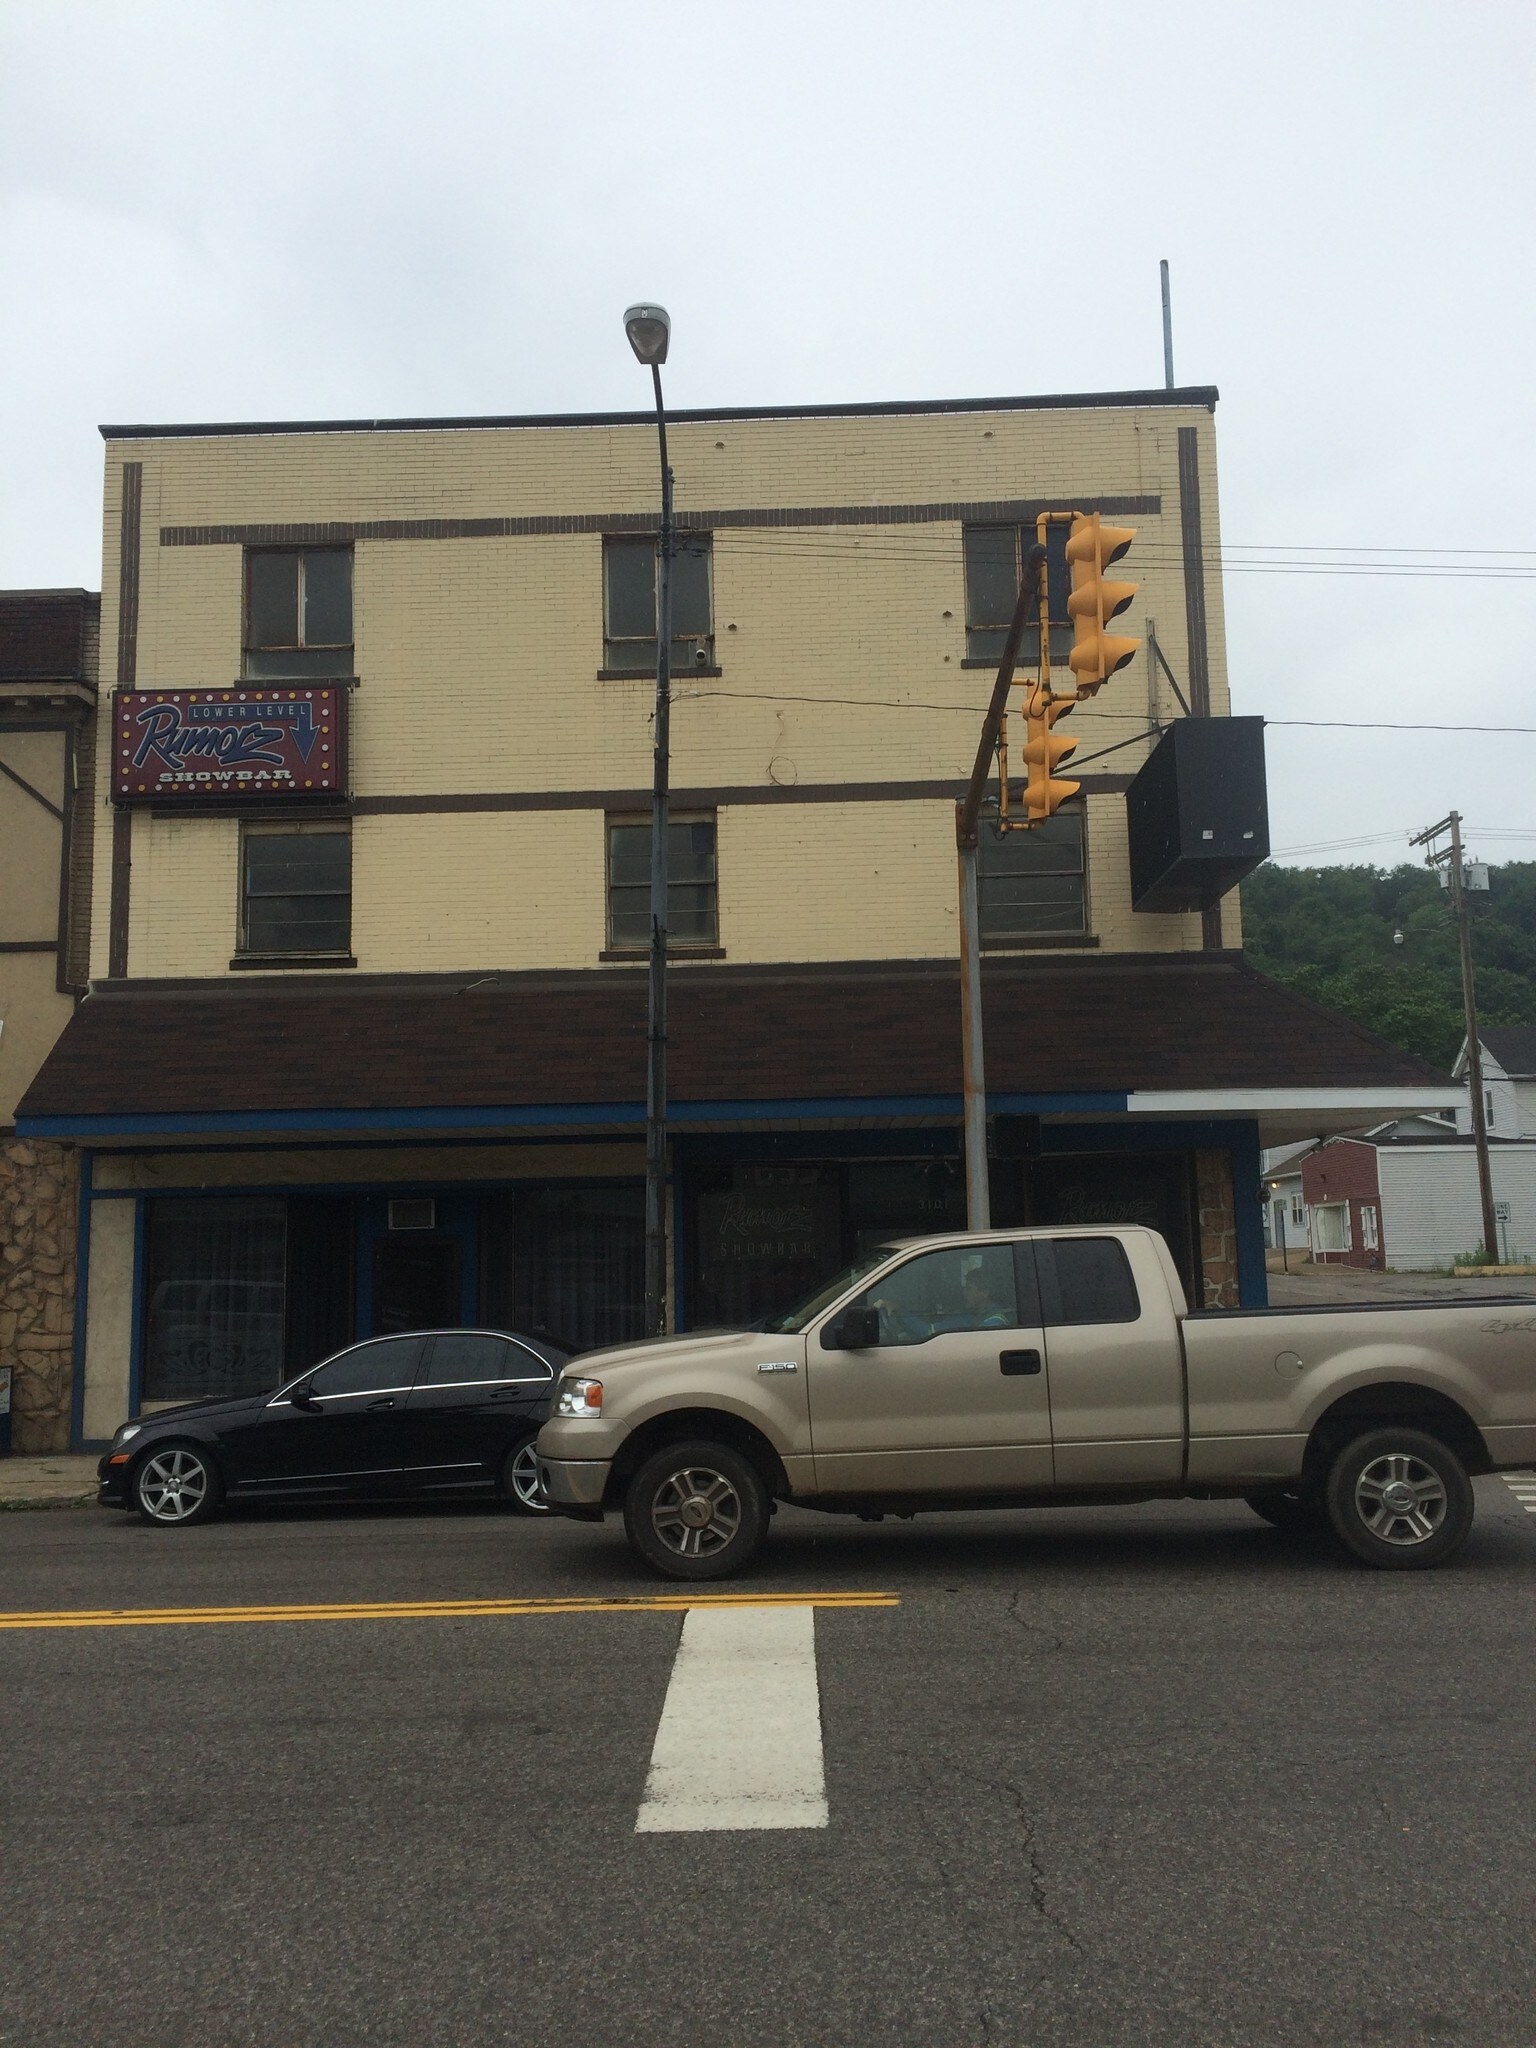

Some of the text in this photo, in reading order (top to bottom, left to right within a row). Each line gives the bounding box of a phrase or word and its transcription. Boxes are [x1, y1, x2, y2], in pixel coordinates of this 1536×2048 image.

[193, 704, 306, 718] LOWER LEVEL
[132, 703, 285, 769] Rumorz
[159, 769, 293, 782] SHOWBAR
